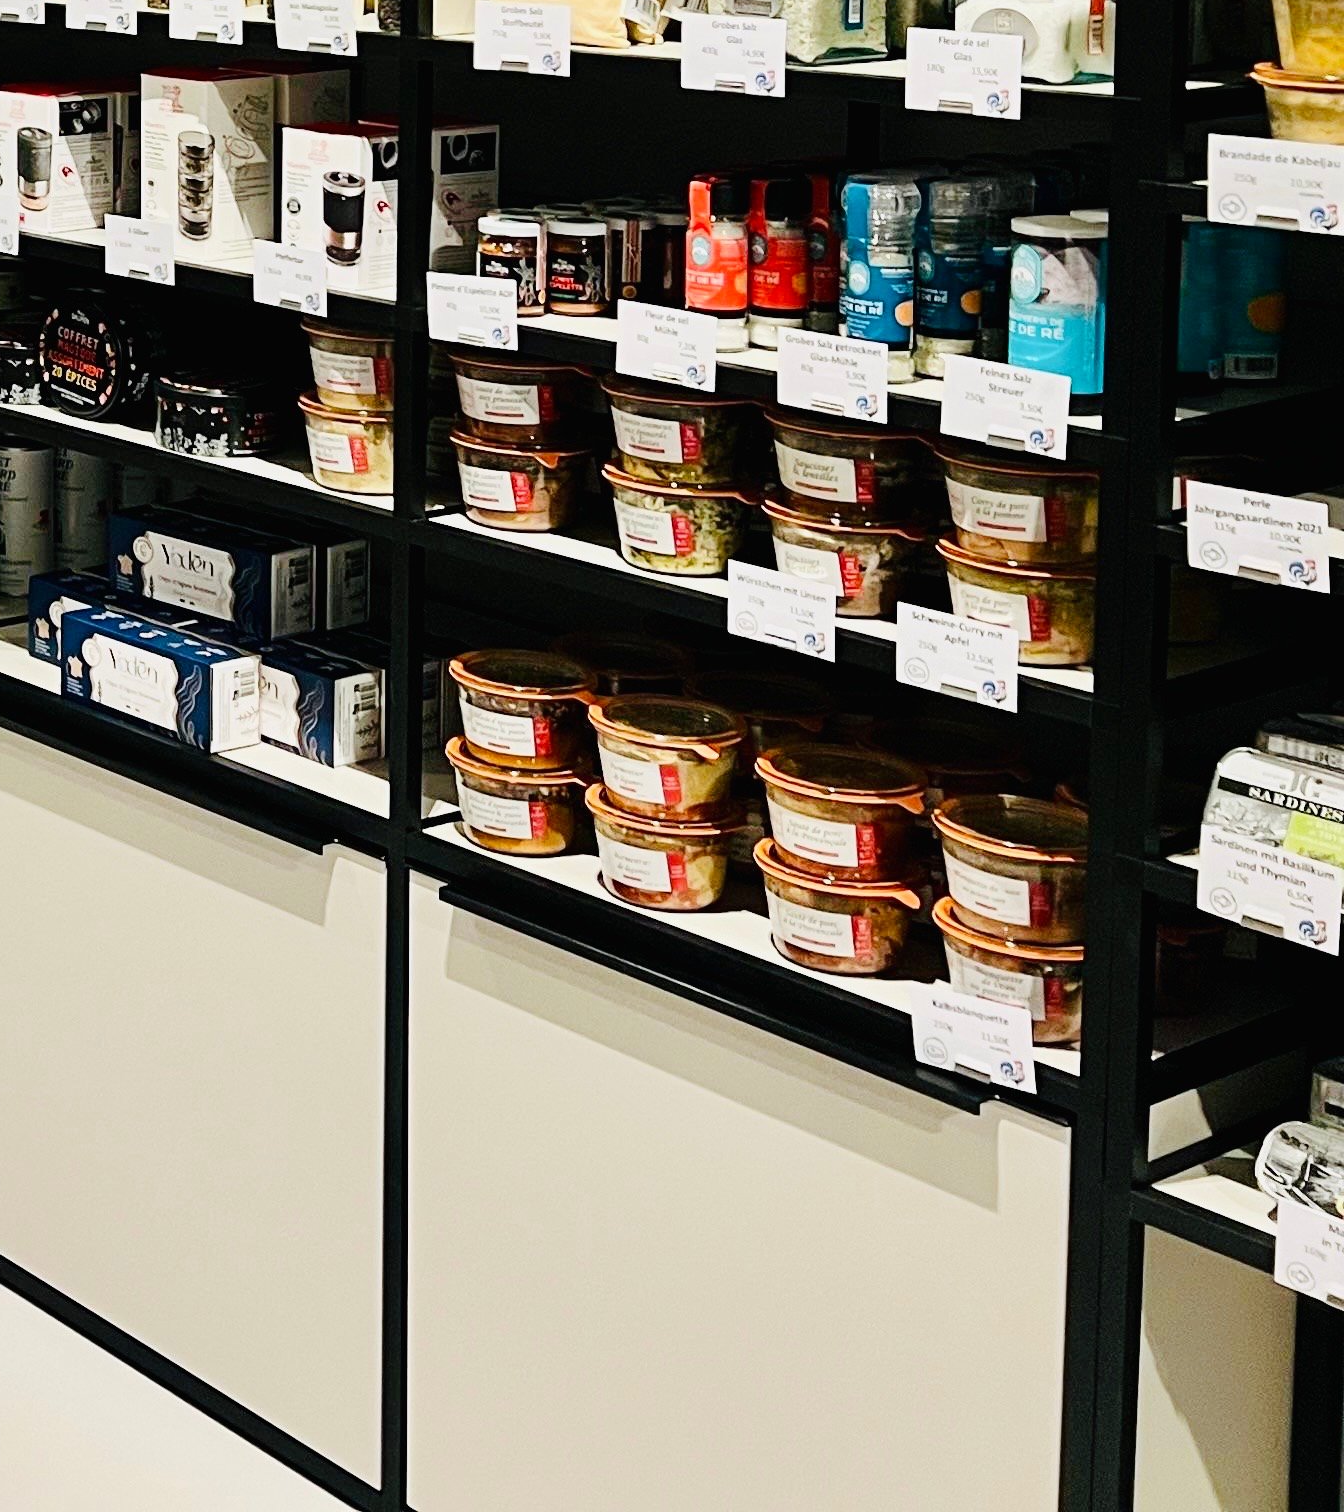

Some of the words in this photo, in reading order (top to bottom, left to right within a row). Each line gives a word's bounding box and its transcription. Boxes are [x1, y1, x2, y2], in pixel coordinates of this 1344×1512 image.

[712, 20, 740, 31] Grobes
[742, 22, 757, 31] Salz
[726, 35, 743, 45] Glas
[938, 35, 959, 47] Fleur
[962, 37, 974, 47] de
[976, 38, 990, 49] sel
[953, 52, 973, 63] Glas
[1219, 149, 1271, 164] Brandade
[1275, 154, 1288, 165] de
[1292, 156, 1341, 169] Kabeljau
[58, 326, 99, 349] COFFRET
[785, 334, 815, 347] Grobes
[817, 338, 833, 350] Salz
[810, 351, 858, 369] Glas-Mühle
[52, 364, 63, 378] 20
[65, 367, 97, 392] ÉPICES
[980, 366, 1011, 381] Feines
[1014, 372, 1032, 385] Salz
[988, 383, 1024, 398] Streuer
[1243, 497, 1271, 510] Perle
[1194, 504, 1293, 529] Jahrgangssardinen
[1297, 522, 1323, 535] 2021
[736, 574, 782, 593] Würstchen
[784, 586, 798, 598] mit
[800, 589, 827, 603] Linsen
[945, 634, 970, 649] Apfel
[1249, 786, 1344, 823] SARDINES
[1211, 835, 1258, 857] Sardinen
[1261, 850, 1278, 864] mit
[1282, 856, 1335, 881] Basilikum
[1236, 860, 1257, 873] und
[1260, 866, 1307, 889] Thymian
